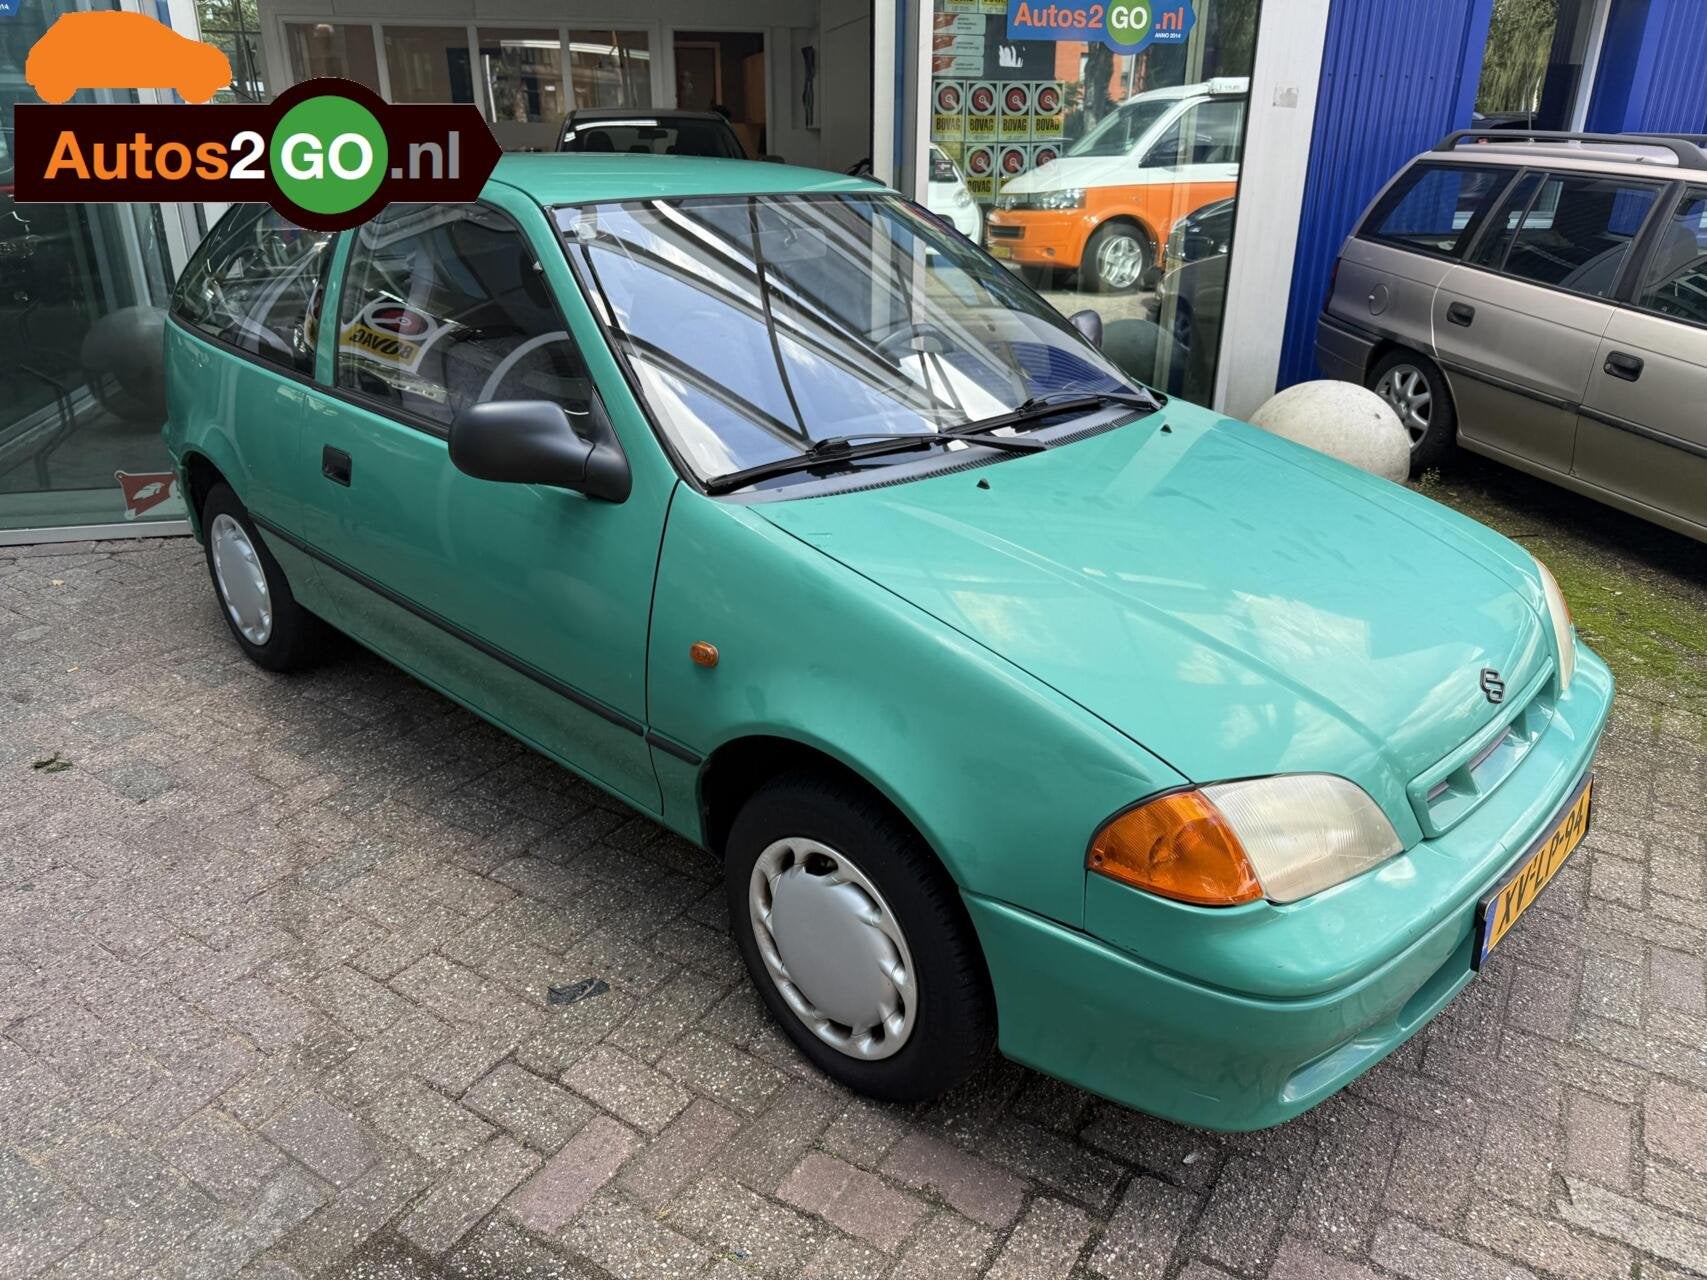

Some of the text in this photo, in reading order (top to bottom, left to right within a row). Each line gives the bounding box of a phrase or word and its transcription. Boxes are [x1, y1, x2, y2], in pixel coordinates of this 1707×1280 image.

[936, 117, 961, 131] BOVAG
[969, 118, 994, 132] BOVAG
[1003, 118, 1027, 132] BOVAG
[1036, 118, 1060, 132] BOVAG
[1496, 795, 1585, 936] XV-LP-94
